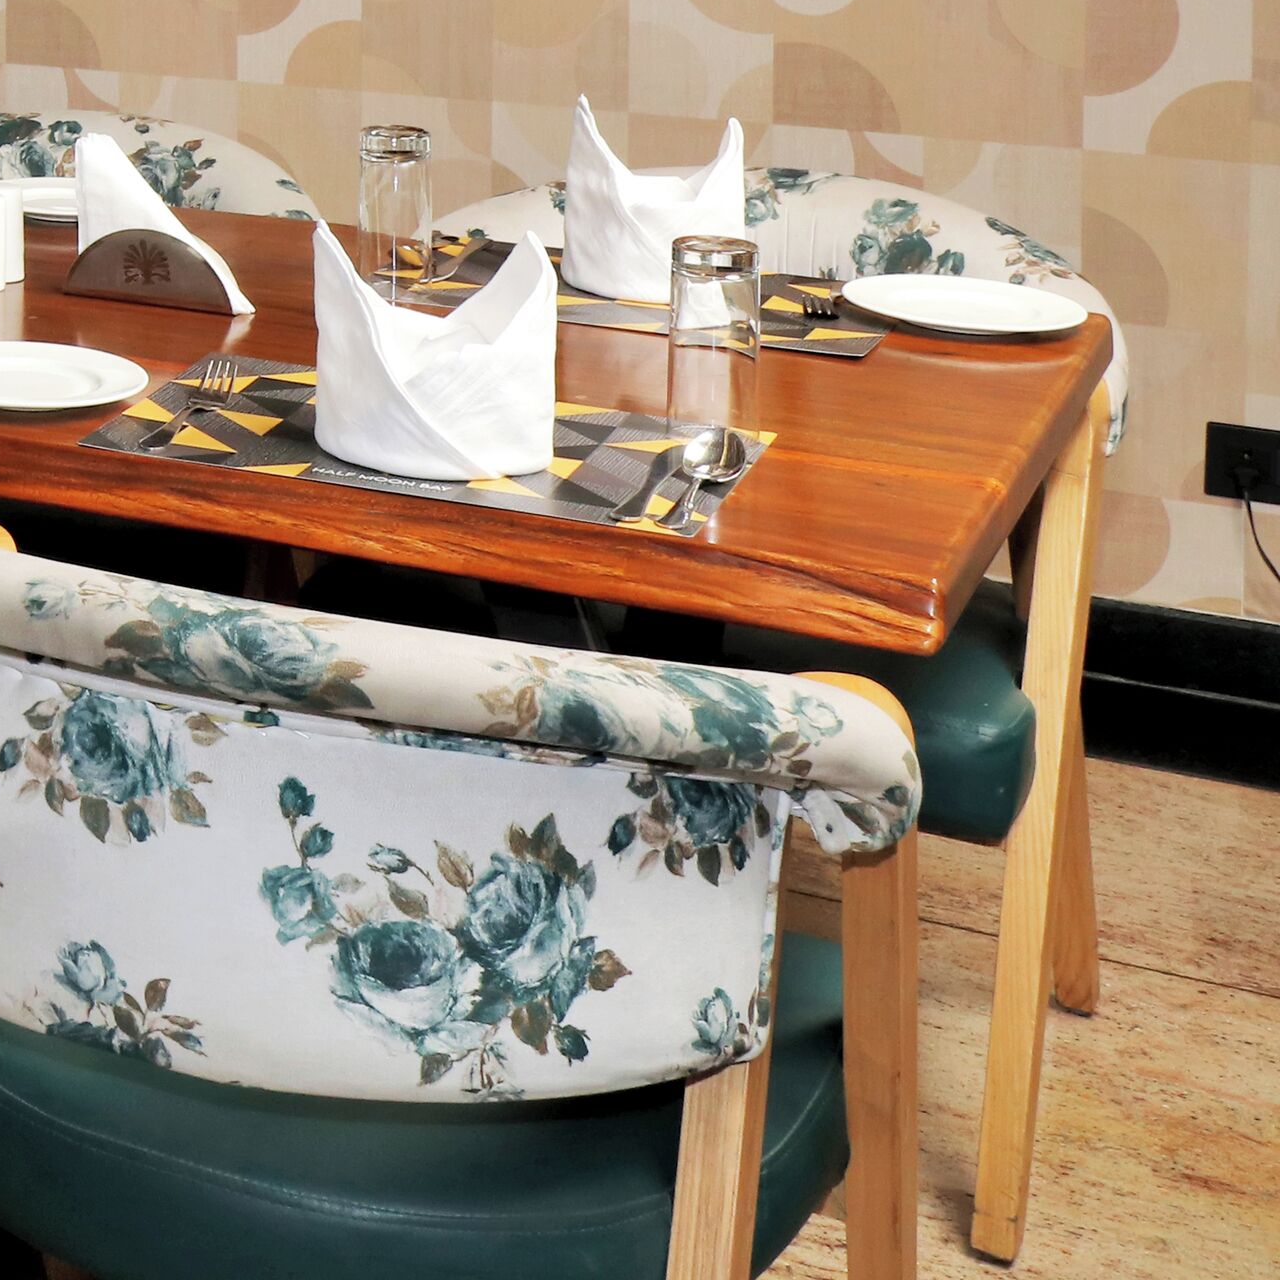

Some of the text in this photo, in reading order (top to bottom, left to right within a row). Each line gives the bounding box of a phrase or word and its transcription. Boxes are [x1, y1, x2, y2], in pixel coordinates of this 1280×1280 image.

[312, 467, 453, 492] HALF MOON BAY
